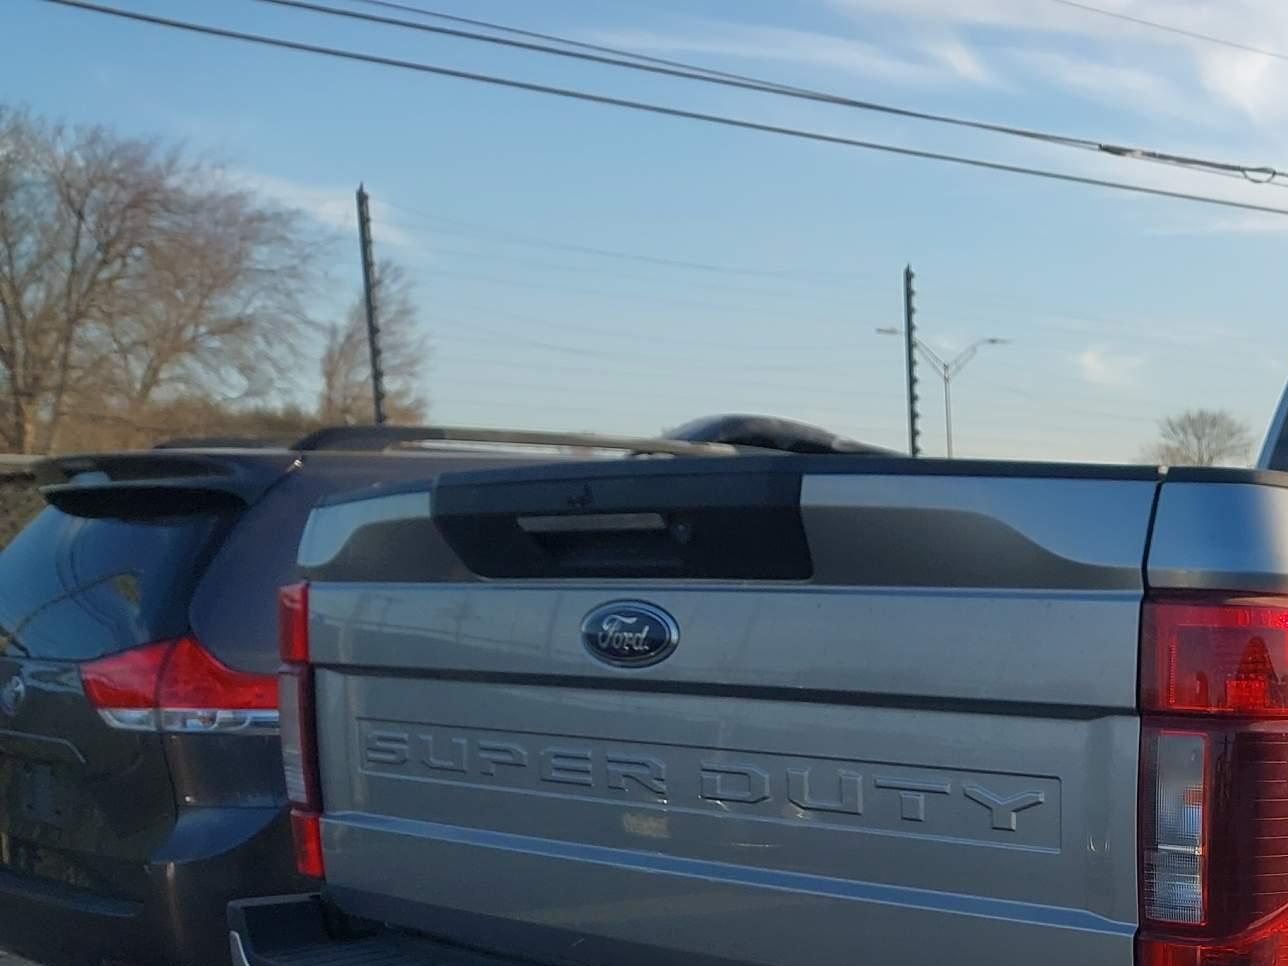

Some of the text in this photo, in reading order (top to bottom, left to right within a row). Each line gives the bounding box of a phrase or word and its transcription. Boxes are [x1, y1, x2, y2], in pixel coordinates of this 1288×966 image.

[598, 614, 650, 651] Ford
[366, 730, 1045, 832] SUPER DUTY
